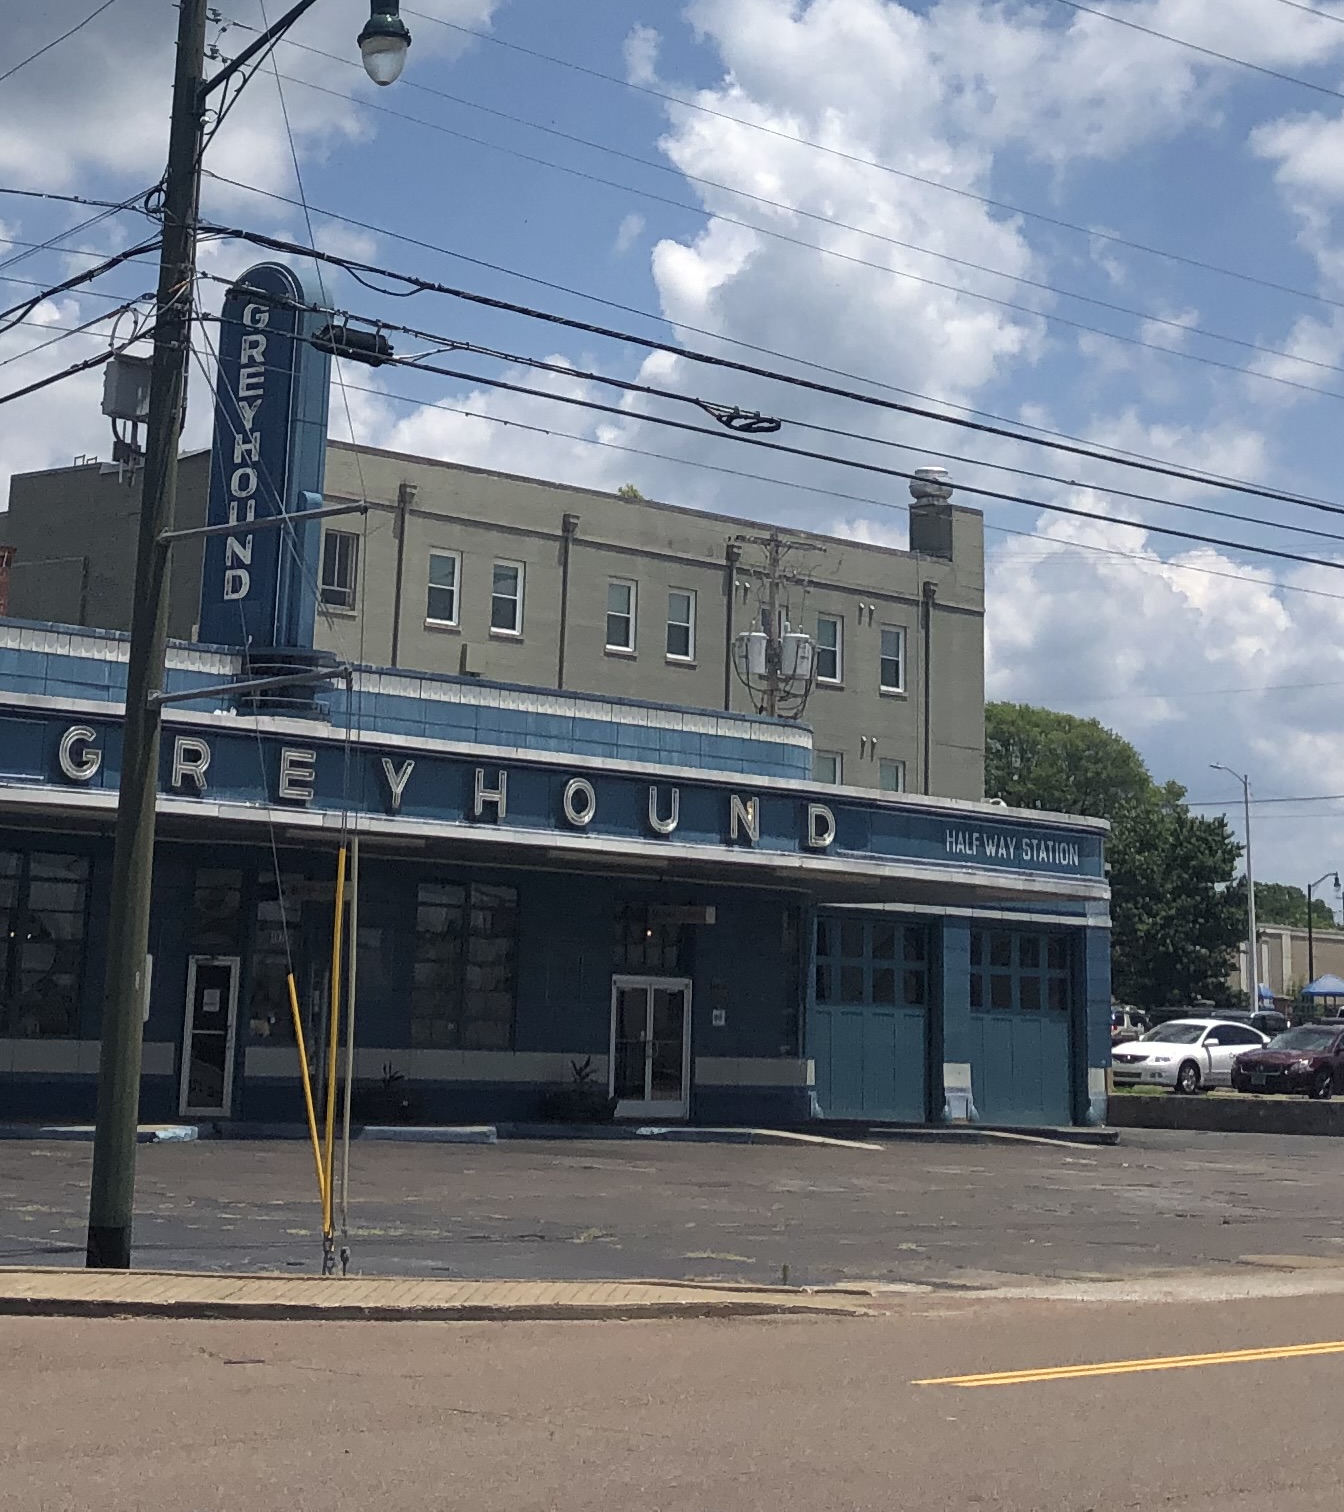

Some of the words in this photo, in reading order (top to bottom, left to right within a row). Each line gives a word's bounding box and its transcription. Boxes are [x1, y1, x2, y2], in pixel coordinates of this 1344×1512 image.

[223, 303, 270, 601] GREYHOUND
[58, 725, 837, 848] GREYHOUND
[946, 829, 981, 856] HALF
[983, 833, 1017, 860] WAY
[1022, 838, 1079, 867] STATION
